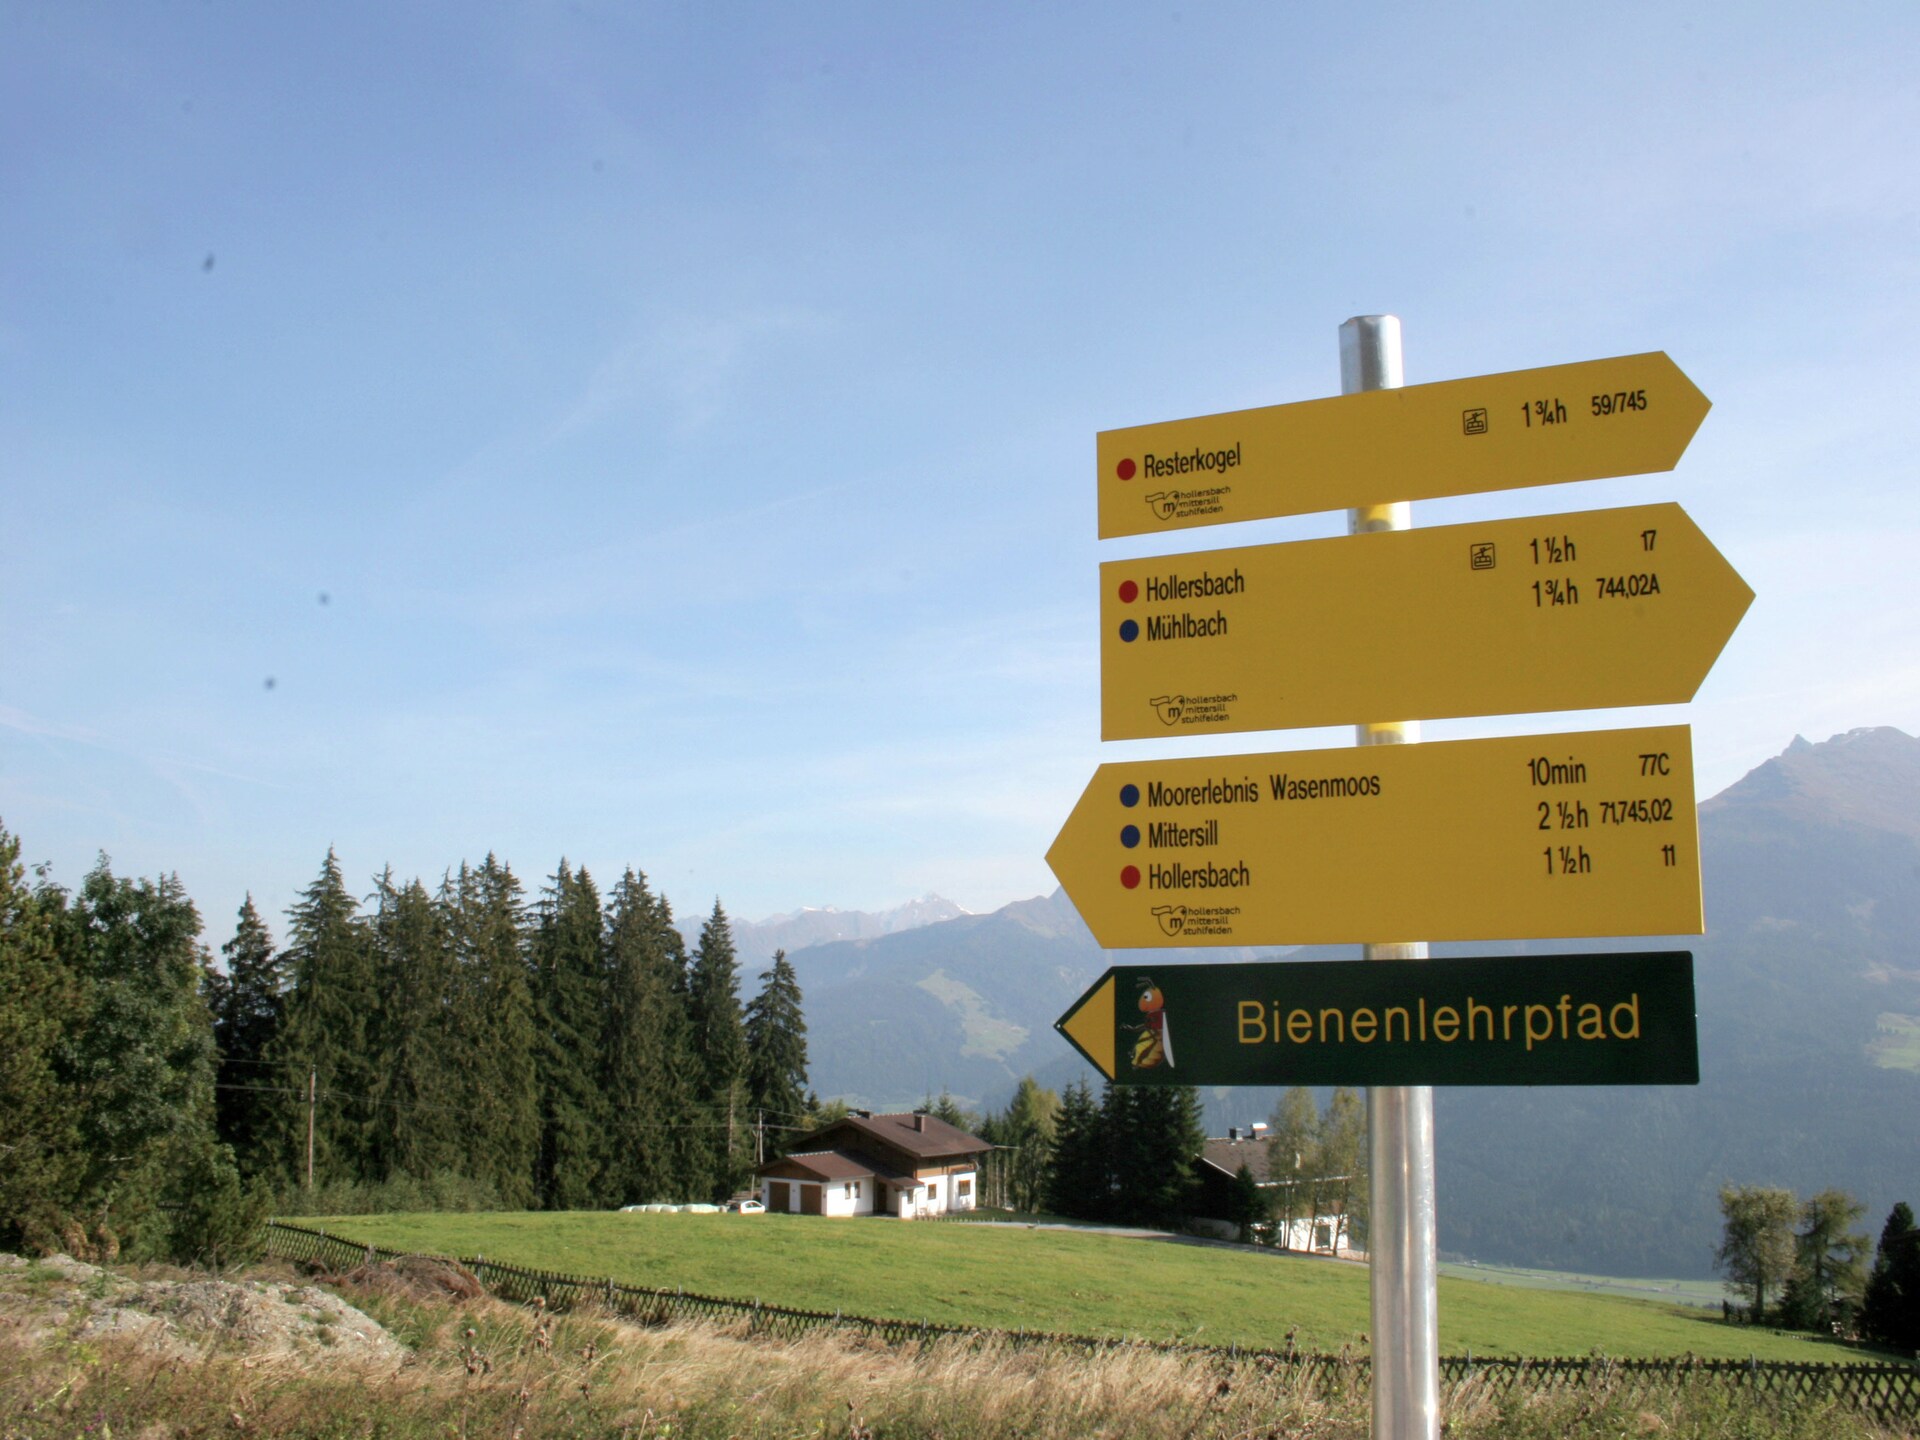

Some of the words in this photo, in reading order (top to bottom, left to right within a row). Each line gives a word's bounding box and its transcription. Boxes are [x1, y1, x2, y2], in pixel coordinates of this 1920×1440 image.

[1591, 389, 1648, 416] 59/745
[1144, 441, 1241, 478] Resterkogel
[1179, 496, 1219, 508] mittersill
[1180, 486, 1231, 499] hollersbach
[1176, 505, 1223, 518] stuhlfelden
[1641, 529, 1657, 551] 17
[1146, 568, 1245, 602] Hollersbach
[1596, 573, 1660, 600] 744,02A
[1147, 610, 1228, 642] Mühlbach
[1185, 704, 1226, 714] mittersill
[1186, 693, 1238, 705] hollersbach
[1181, 713, 1229, 724] stuhlfelden
[1527, 756, 1586, 786] 10min
[1639, 753, 1670, 776] 77C
[1148, 776, 1259, 808] Moorerlebnis
[1269, 773, 1381, 801] Wasenmoos
[1600, 798, 1673, 826] 71,745,02
[1148, 819, 1218, 848] Mittersill
[1661, 844, 1676, 866] 11
[1149, 860, 1250, 889] Hollersbach
[1187, 916, 1229, 926] mittersill
[1188, 905, 1241, 916] hollersbach
[1183, 925, 1232, 936] stuhlfelden
[1237, 993, 1640, 1051] Bienenlehrpfad
